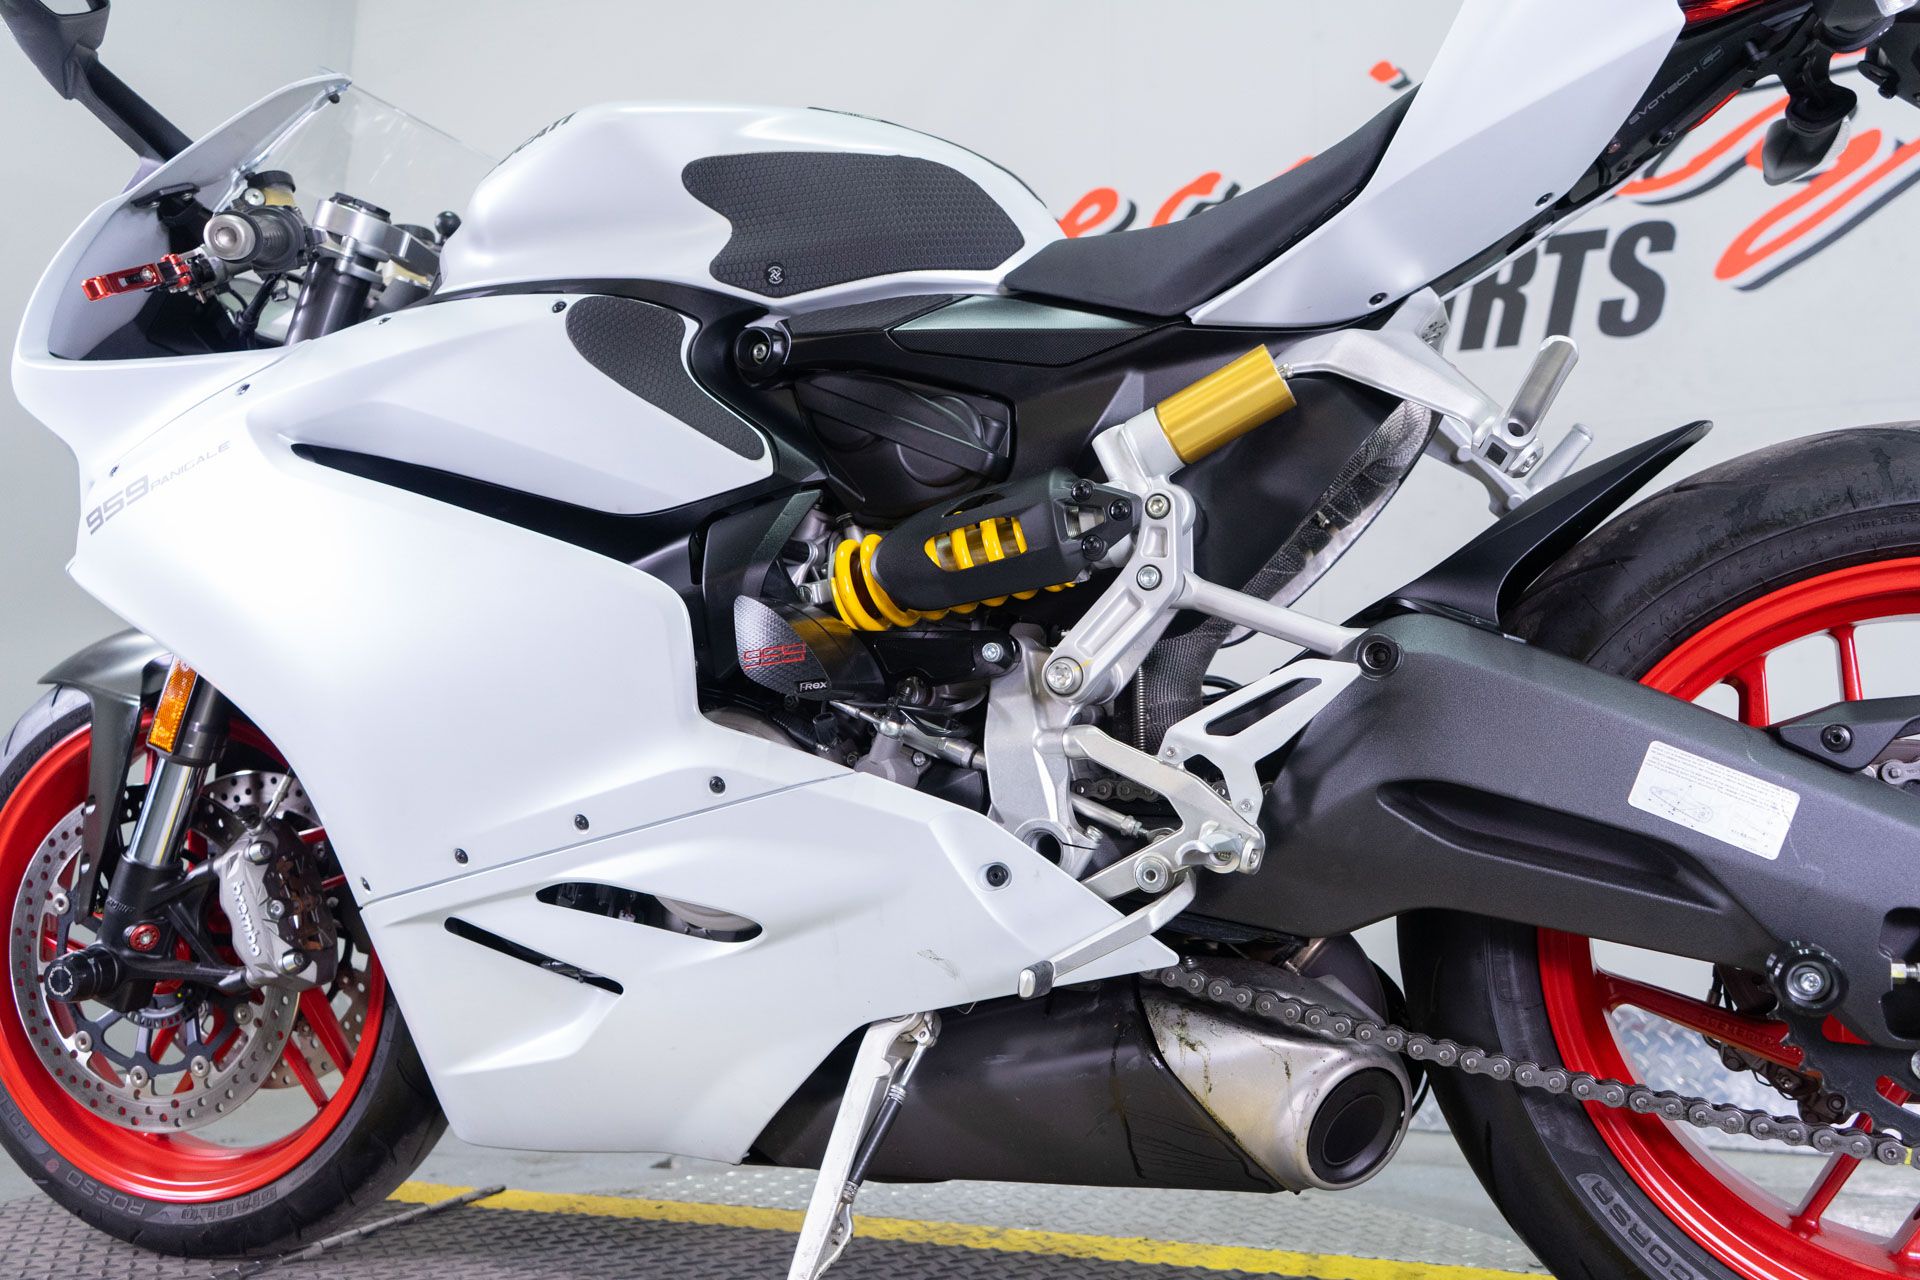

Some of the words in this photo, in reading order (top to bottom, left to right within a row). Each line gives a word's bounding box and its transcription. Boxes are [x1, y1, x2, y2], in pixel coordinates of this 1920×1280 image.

[1628, 66, 1699, 125] EVOTECH
[1443, 220, 1677, 352] RTS
[86, 474, 149, 536] 959
[743, 641, 806, 669] 959
[232, 880, 262, 957] brembo
[67, 1169, 146, 1216] ROSSO
[1591, 1181, 1695, 1280] CORSA
